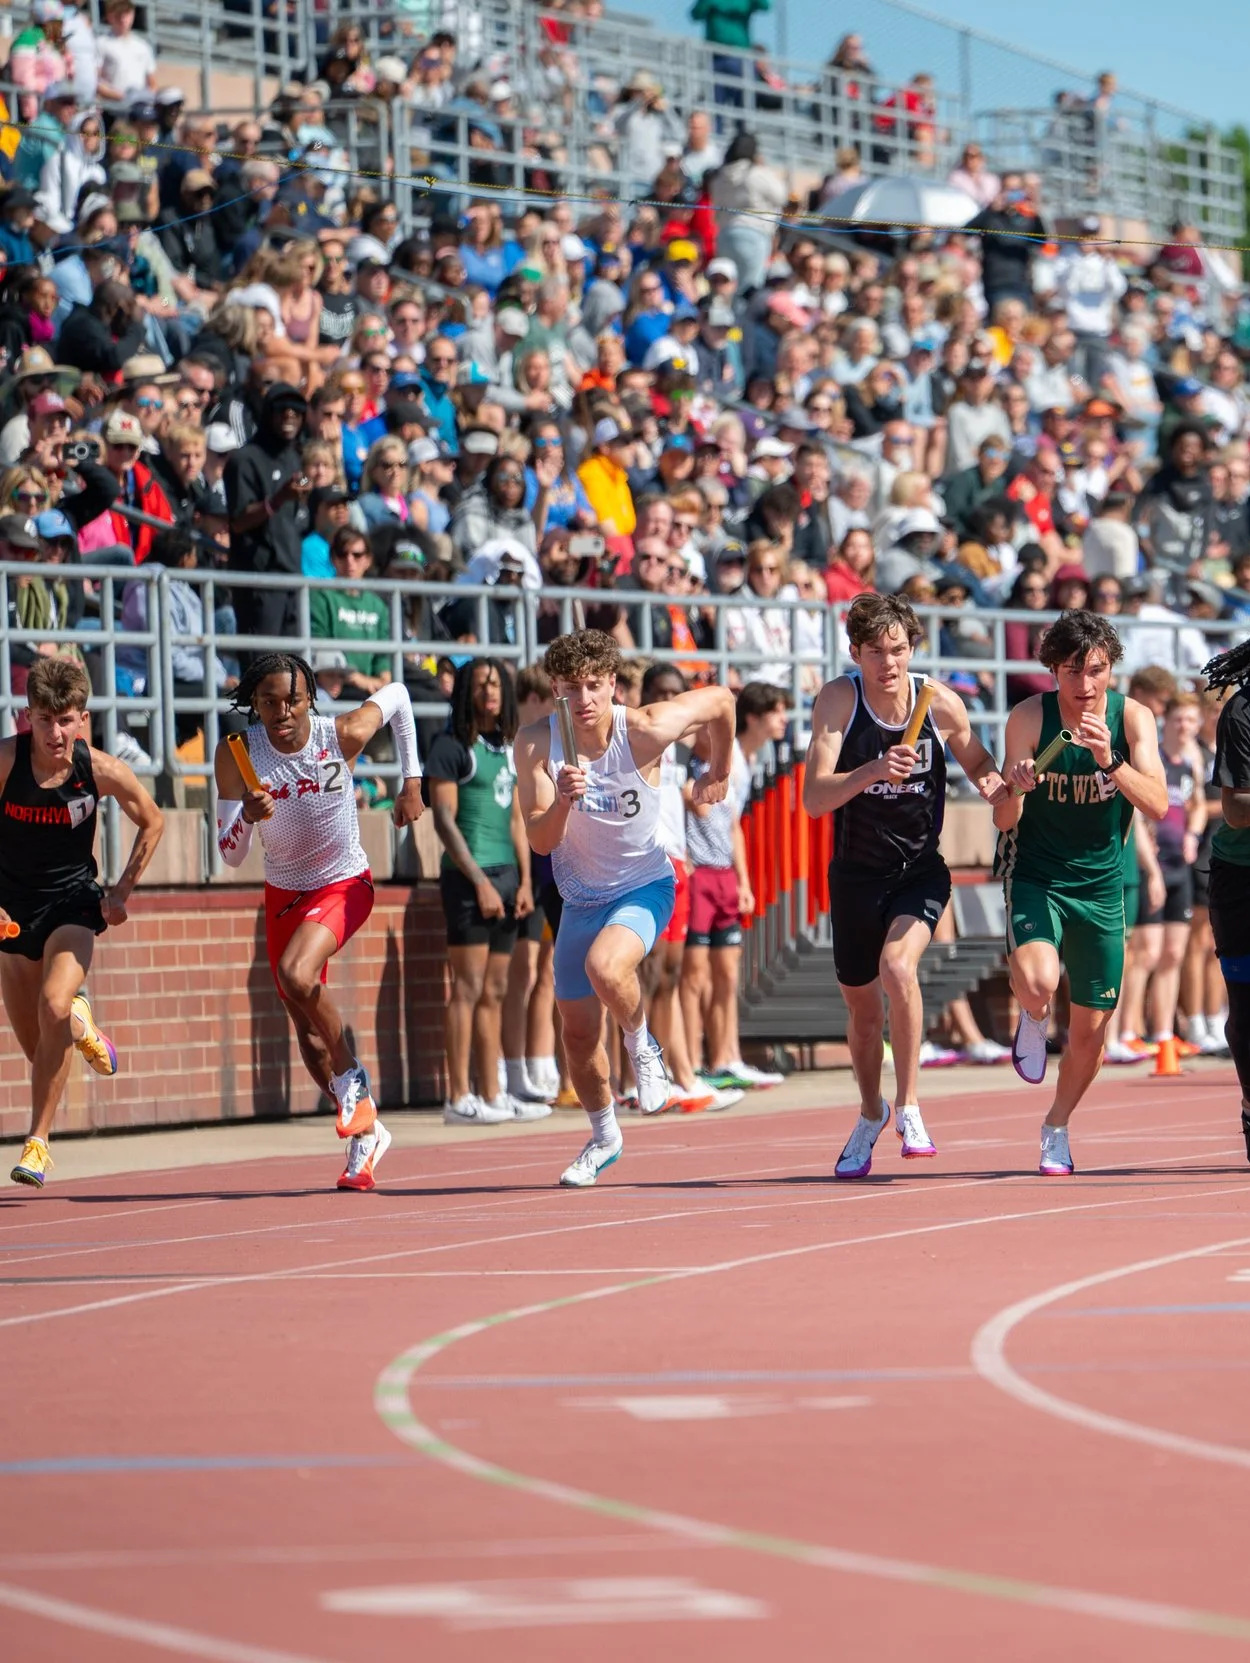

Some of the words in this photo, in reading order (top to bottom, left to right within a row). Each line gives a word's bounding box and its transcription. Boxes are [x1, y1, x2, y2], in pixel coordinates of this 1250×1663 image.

[322, 762, 342, 793] 2
[1046, 772, 1068, 803] TC
[5, 801, 71, 824] NORTHVI
[77, 802, 87, 819] 1
[620, 789, 641, 818] 3
